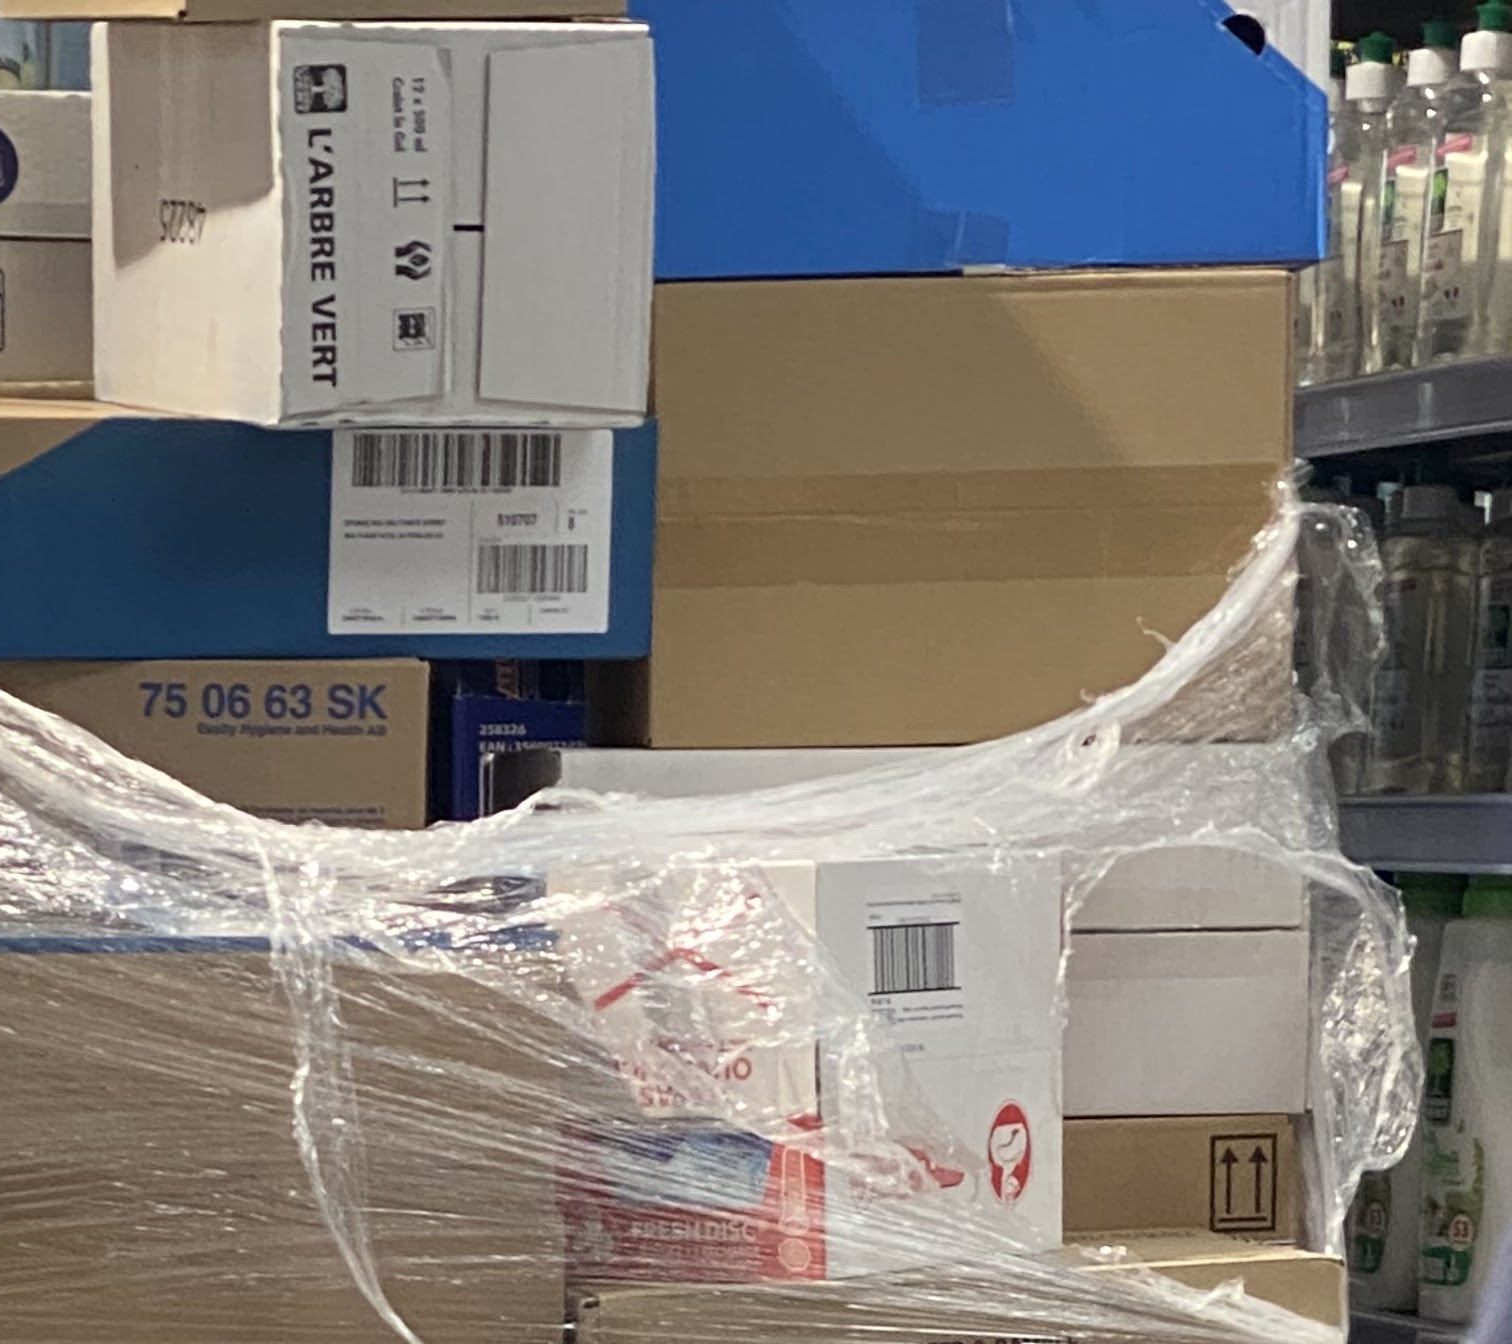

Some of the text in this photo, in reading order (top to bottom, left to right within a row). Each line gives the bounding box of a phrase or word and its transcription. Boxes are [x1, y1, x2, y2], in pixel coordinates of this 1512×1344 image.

[308, 128, 337, 387] L'ARBRE VERT
[139, 682, 387, 719] 75 06 63 SK
[294, 723, 319, 735] and
